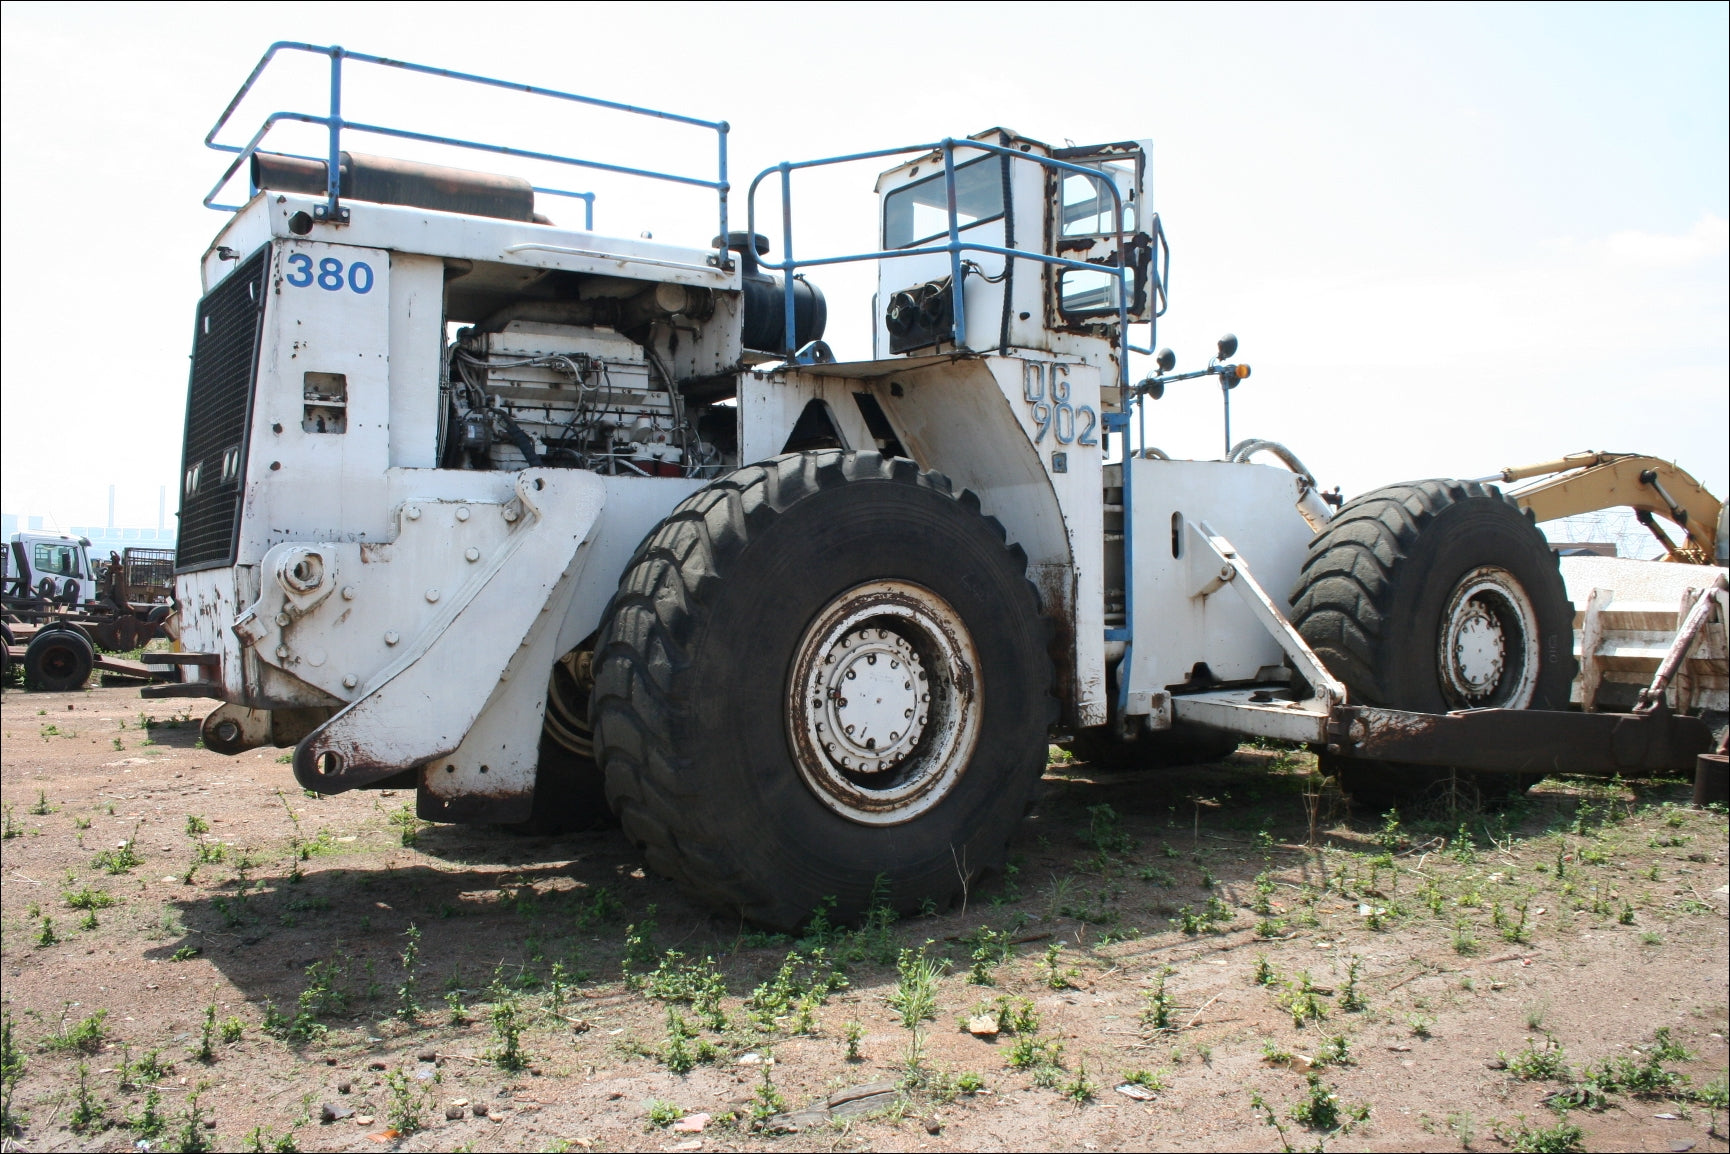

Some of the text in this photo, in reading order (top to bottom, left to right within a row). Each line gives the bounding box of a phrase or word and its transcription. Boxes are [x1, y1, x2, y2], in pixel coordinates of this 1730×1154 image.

[286, 253, 374, 294] 380
[1023, 361, 1070, 402] DG
[1032, 401, 1098, 446] 902
